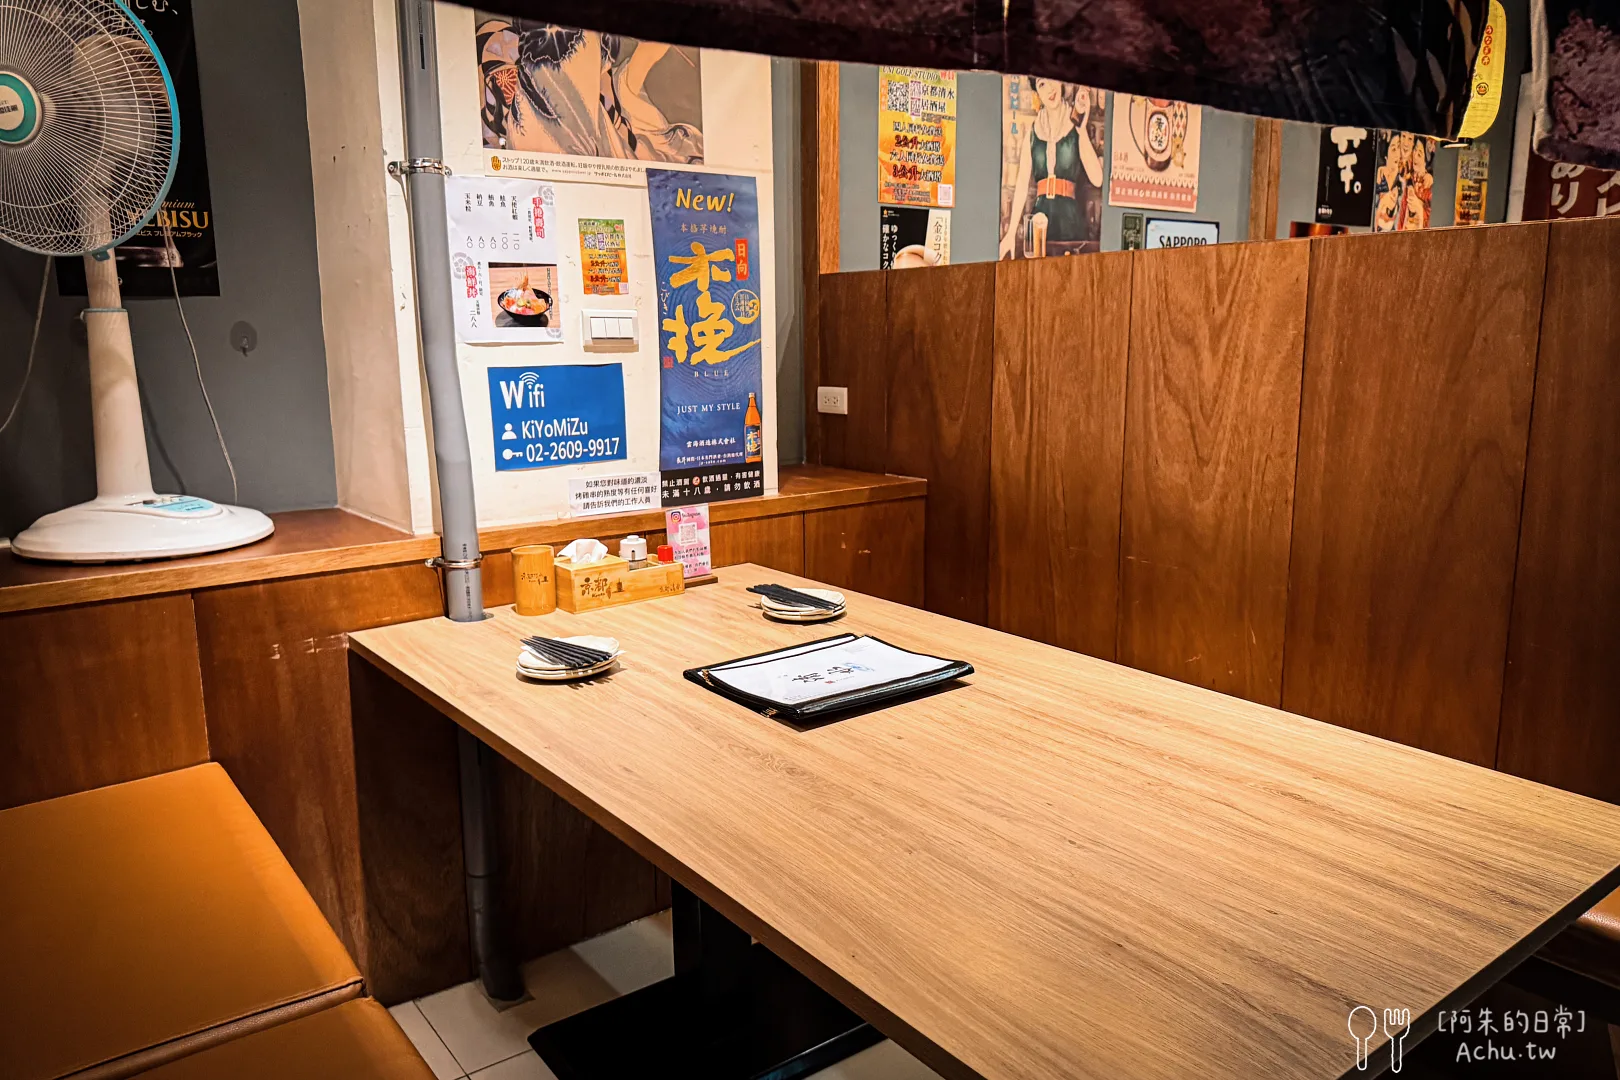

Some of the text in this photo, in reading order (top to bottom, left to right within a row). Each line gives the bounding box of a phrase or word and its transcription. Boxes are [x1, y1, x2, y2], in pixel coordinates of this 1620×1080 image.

[922, 84, 955, 100] 京都清水
[921, 99, 946, 113] 居酒屋
[464, 192, 472, 212] 玉米粒
[476, 193, 484, 207] 納豆
[675, 187, 735, 213] New!
[153, 230, 203, 238] プレアムブラック
[737, 243, 748, 276] 日向
[694, 369, 730, 378] BLUE
[499, 380, 545, 410] Wifi
[677, 402, 741, 415] JUST MY STYLE
[521, 417, 589, 440] KiYoMiZu
[526, 437, 620, 463] 02-2609-9917
[582, 496, 651, 510] 請告訴我們的工作人員
